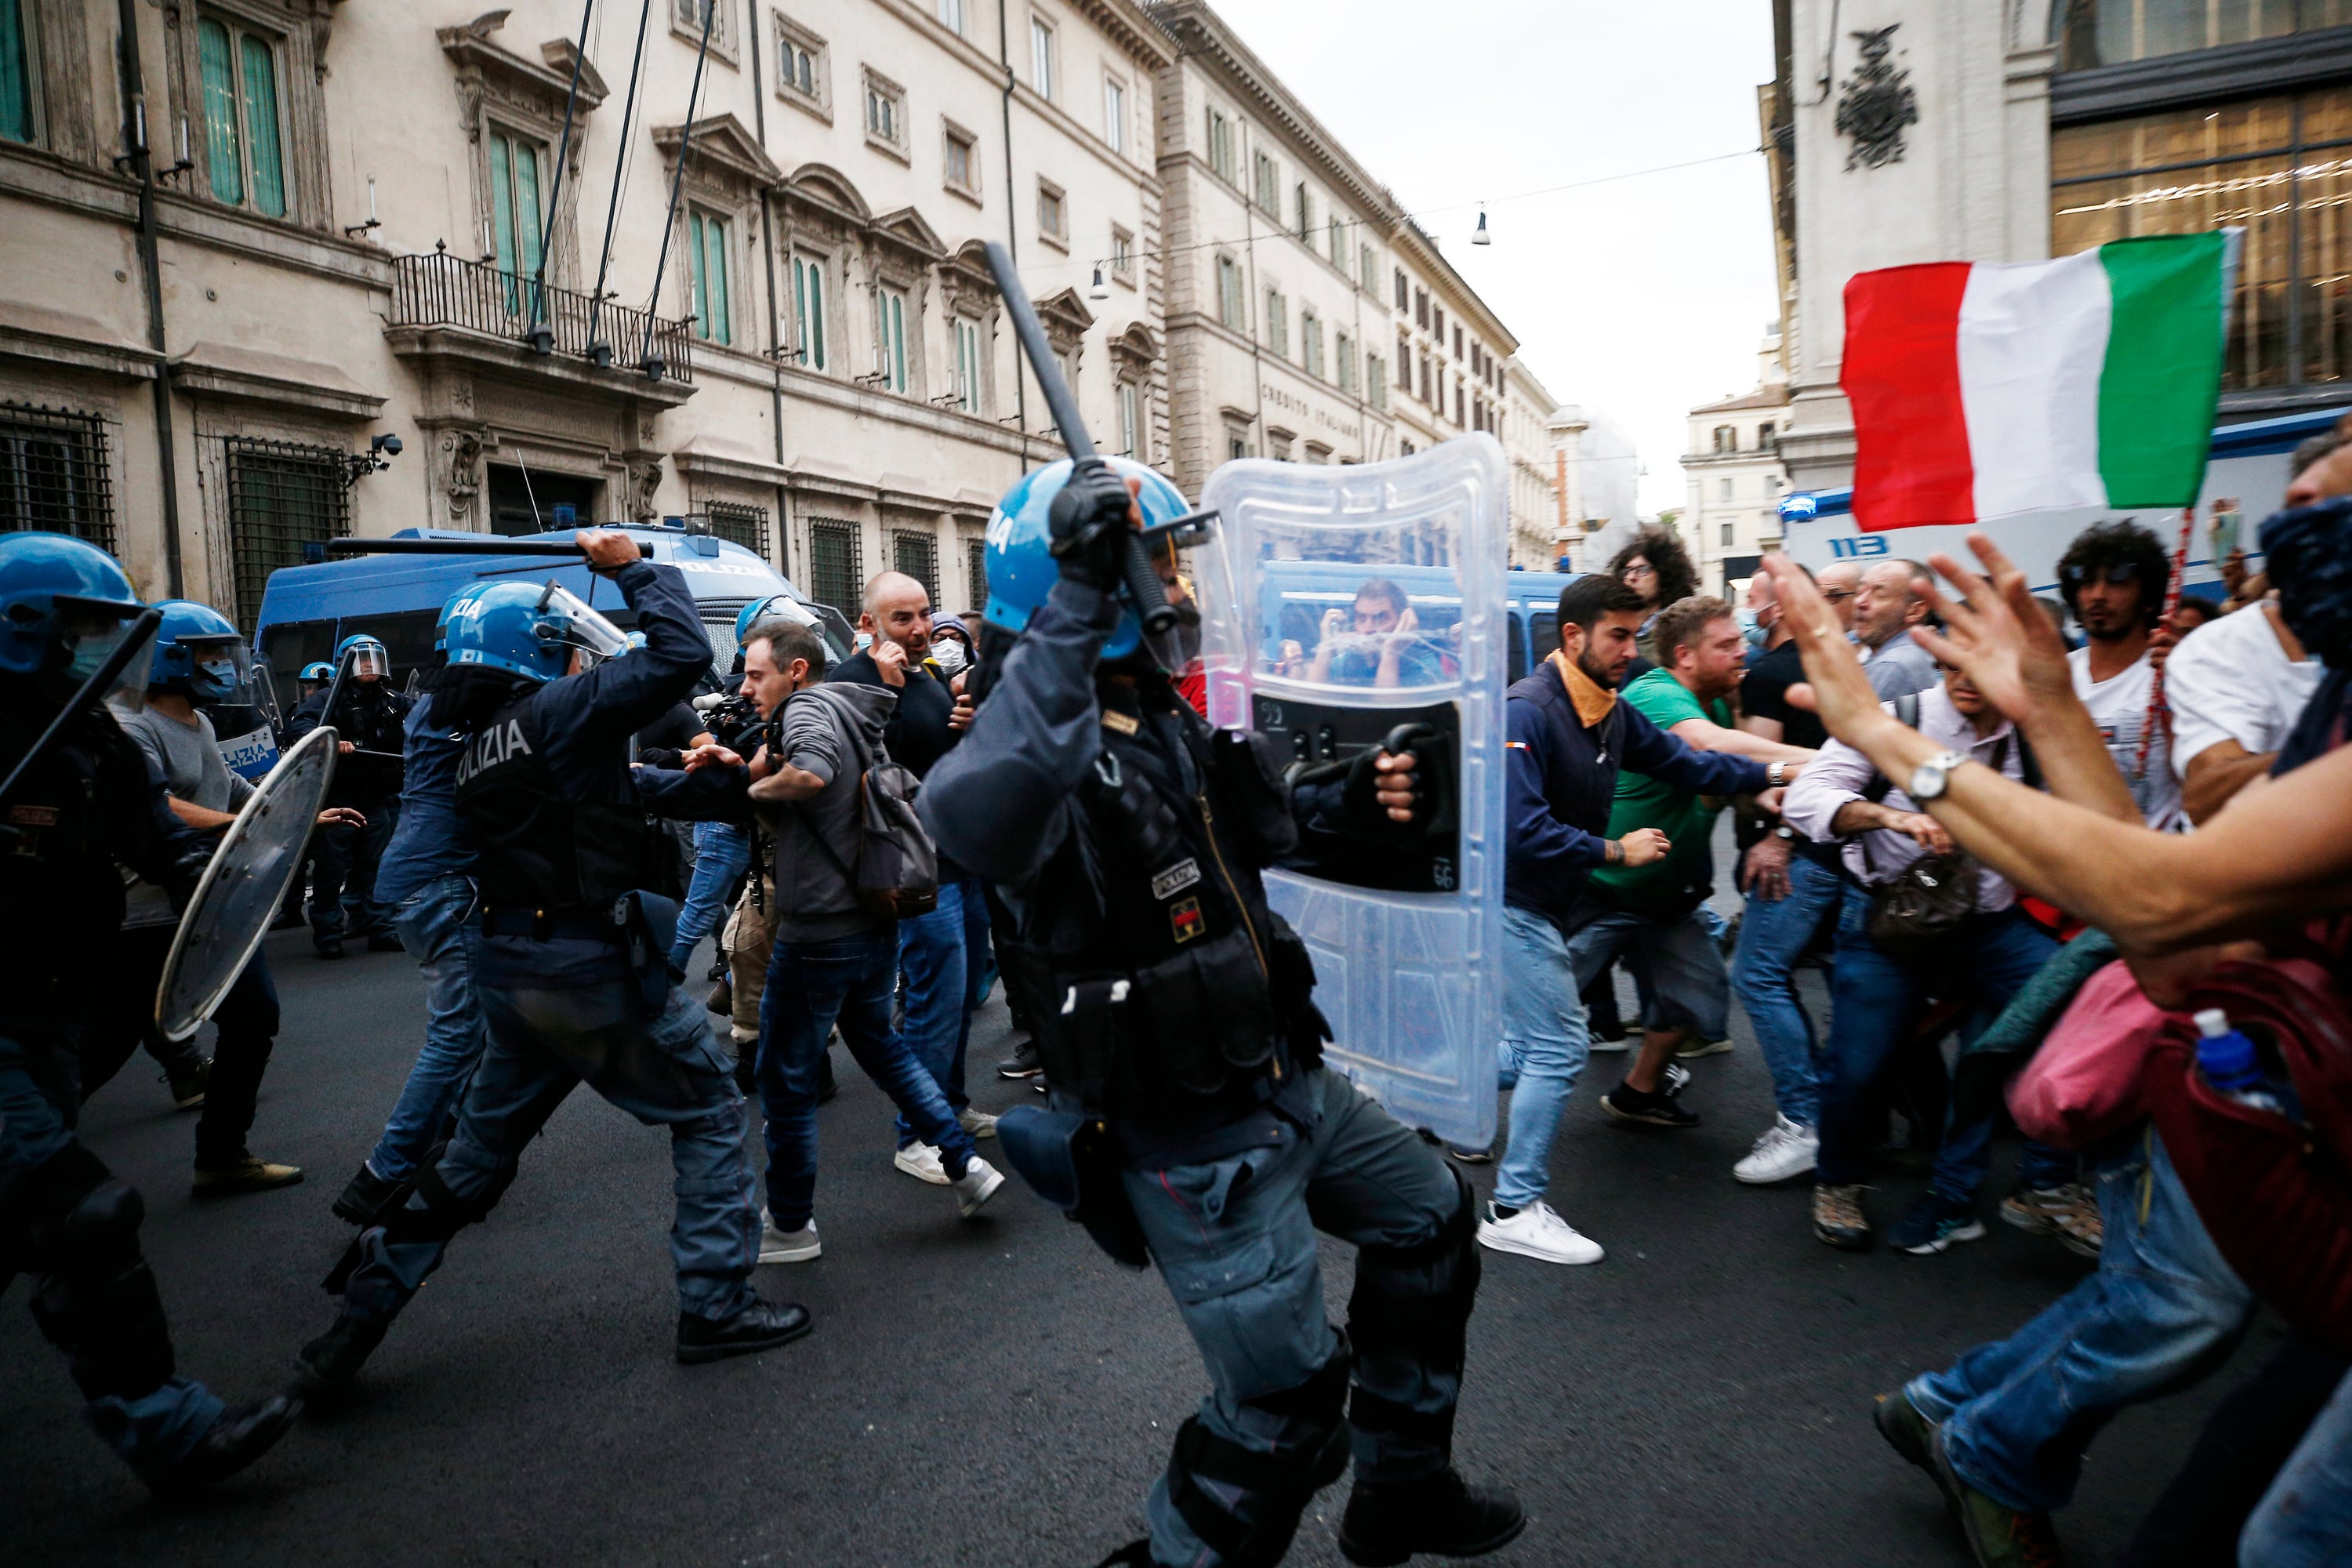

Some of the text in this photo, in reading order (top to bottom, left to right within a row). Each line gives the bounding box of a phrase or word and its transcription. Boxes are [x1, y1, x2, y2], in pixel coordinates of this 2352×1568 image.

[1261, 384, 1308, 416] CREDITO
[1828, 535, 1889, 557] 113
[456, 718, 533, 786] OLIZIA
